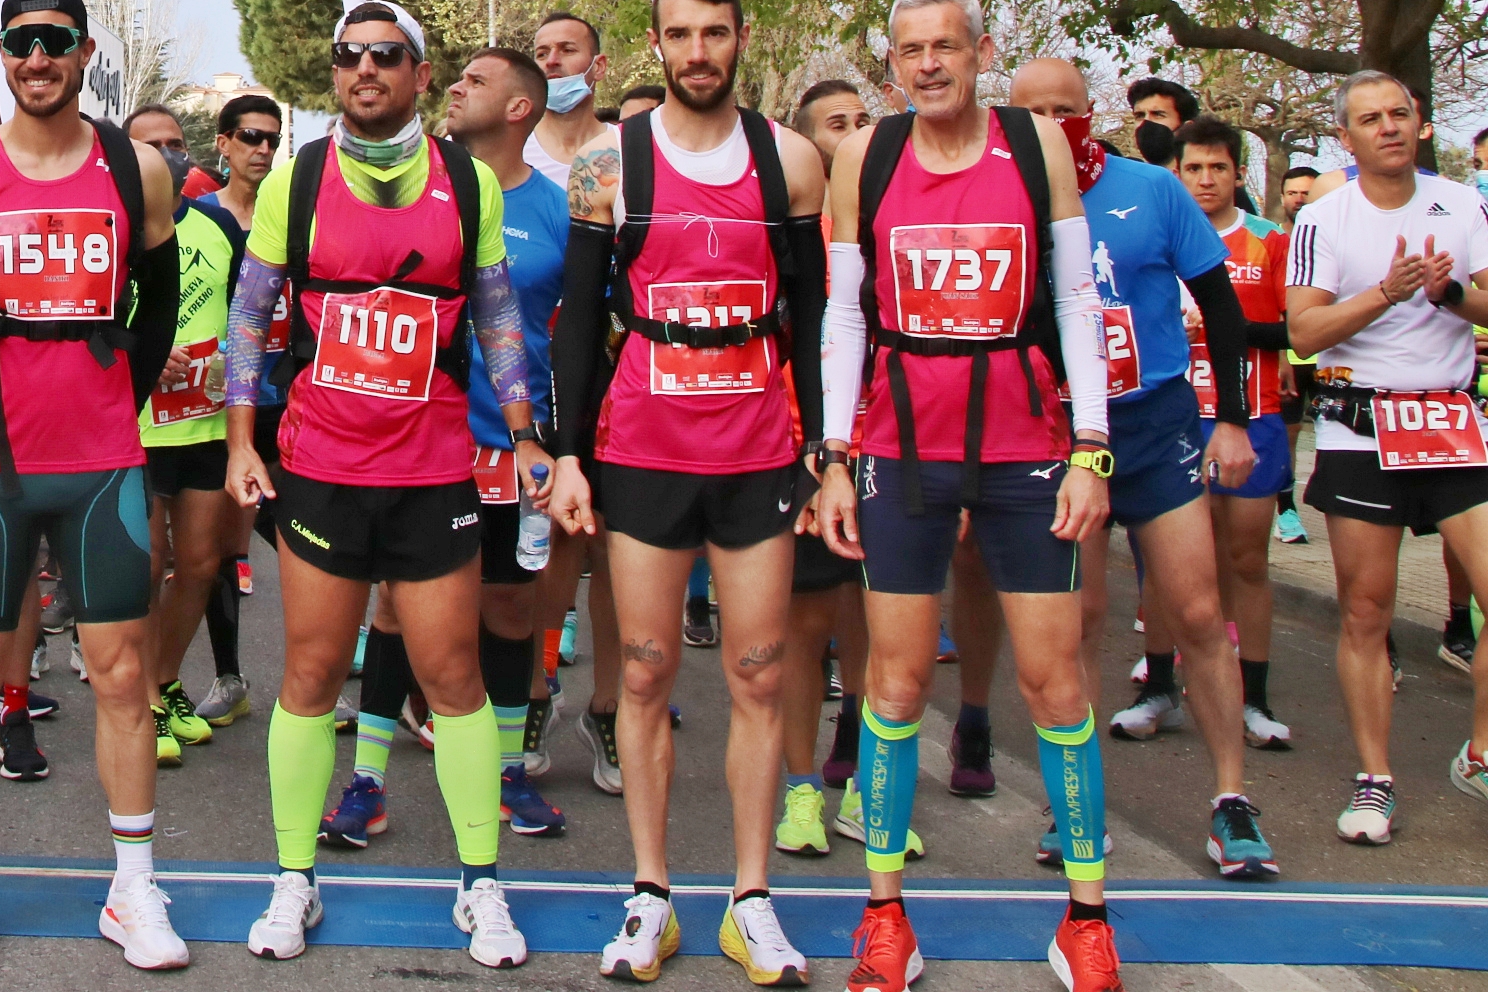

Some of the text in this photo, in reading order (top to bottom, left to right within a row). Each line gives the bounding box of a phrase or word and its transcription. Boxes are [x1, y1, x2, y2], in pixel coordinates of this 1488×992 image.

[0, 233, 110, 274] 1548
[502, 226, 529, 241] HOKA
[907, 249, 1012, 291] 1737
[177, 286, 214, 329] DEL FRESNO
[339, 304, 418, 354] 1110
[1380, 400, 1469, 432] 1027
